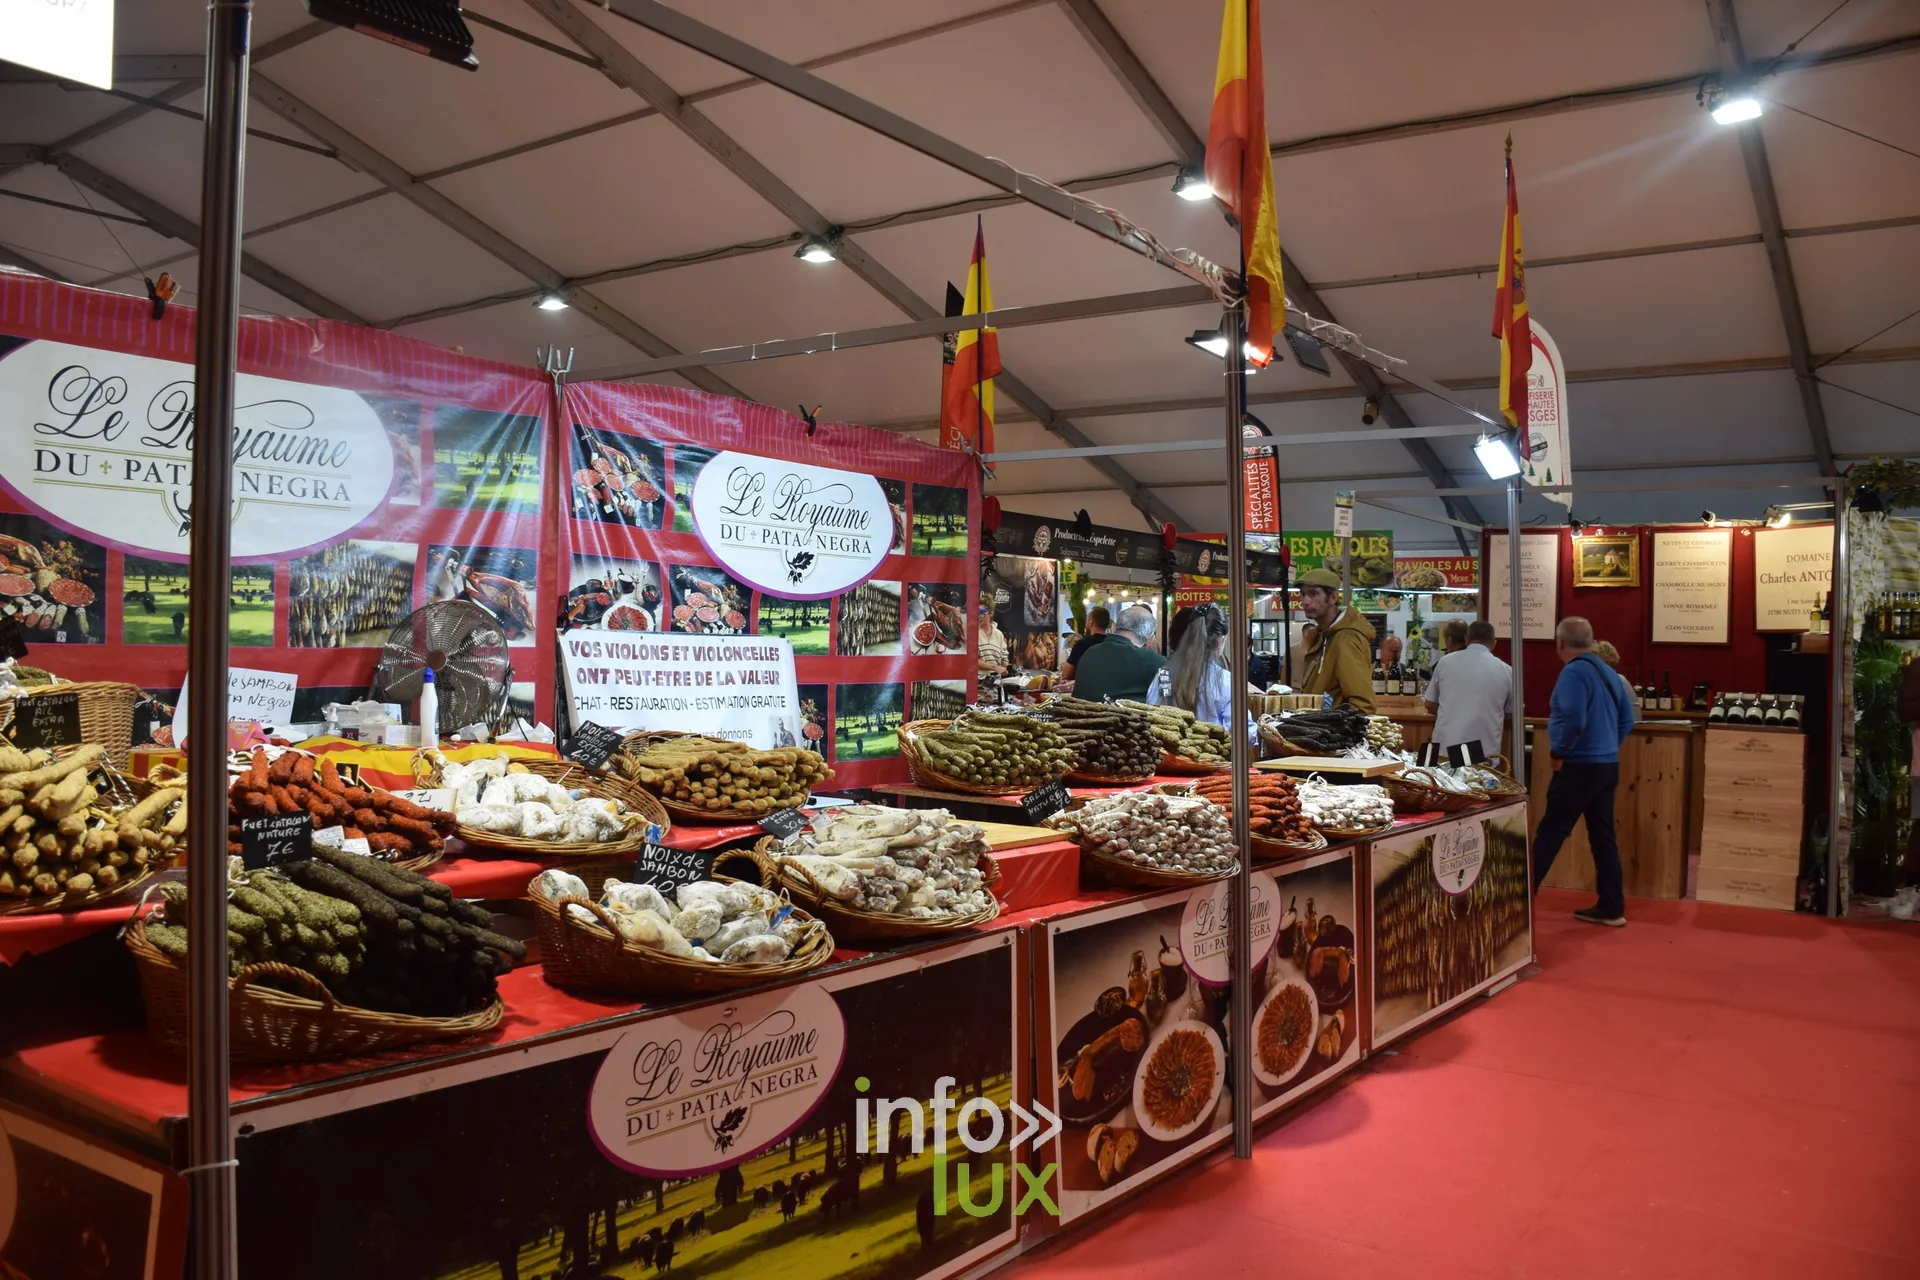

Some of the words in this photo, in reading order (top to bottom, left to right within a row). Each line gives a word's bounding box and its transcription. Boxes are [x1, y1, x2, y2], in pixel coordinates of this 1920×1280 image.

[1528, 390, 1554, 400] FISERIE
[34, 364, 130, 442] Le
[141, 380, 353, 470] Ryaume
[1528, 410, 1556, 421] SGES
[34, 448, 90, 477] DU
[124, 458, 194, 488] PAT
[239, 470, 352, 503] NEGRA
[1259, 461, 1272, 499] BASQUE
[720, 466, 765, 517] Le
[770, 473, 872, 546] Royaume
[1245, 462, 1264, 530] SPÉCIALITÉS
[1263, 501, 1273, 523] PAYS
[720, 523, 746, 542] DU
[762, 528, 803, 547] PATA
[816, 534, 872, 554] NEGRA
[1395, 560, 1452, 571] RAVIOLES
[1454, 560, 1470, 570] AU
[1786, 552, 1831, 563] DOMAINE
[1760, 572, 1797, 584] Charles
[1799, 569, 1832, 583] ANTO
[1175, 592, 1211, 601] BOITES
[1271, 600, 1278, 610] A
[568, 640, 603, 658] VOS
[604, 642, 670, 661] VIOLONS
[671, 645, 690, 661] ET
[692, 645, 780, 662] VIOLONCELLES
[576, 667, 610, 685] ONT
[694, 670, 714, 686] DE
[716, 670, 736, 686] LA
[737, 669, 780, 686] VALEUR
[610, 696, 689, 711] RESTAURATION
[695, 696, 750, 711] ESTIMATION
[32, 715, 65, 727] EXTRA
[346, 732, 355, 740] XL
[577, 739, 608, 759] EXTRA
[1023, 781, 1058, 807] SALAME
[241, 818, 268, 831] FUET
[257, 827, 302, 841] NATURE
[640, 859, 702, 881] JAMBON
[682, 853, 705, 869] de
[1193, 898, 1216, 939] Le
[1193, 942, 1208, 957] DU
[1249, 922, 1272, 939] EGRA
[625, 1038, 684, 1106] Le
[690, 1009, 820, 1102] Royaume
[626, 1109, 661, 1137] DU
[680, 1089, 732, 1121] PATA
[750, 1063, 819, 1099] NEGRA
